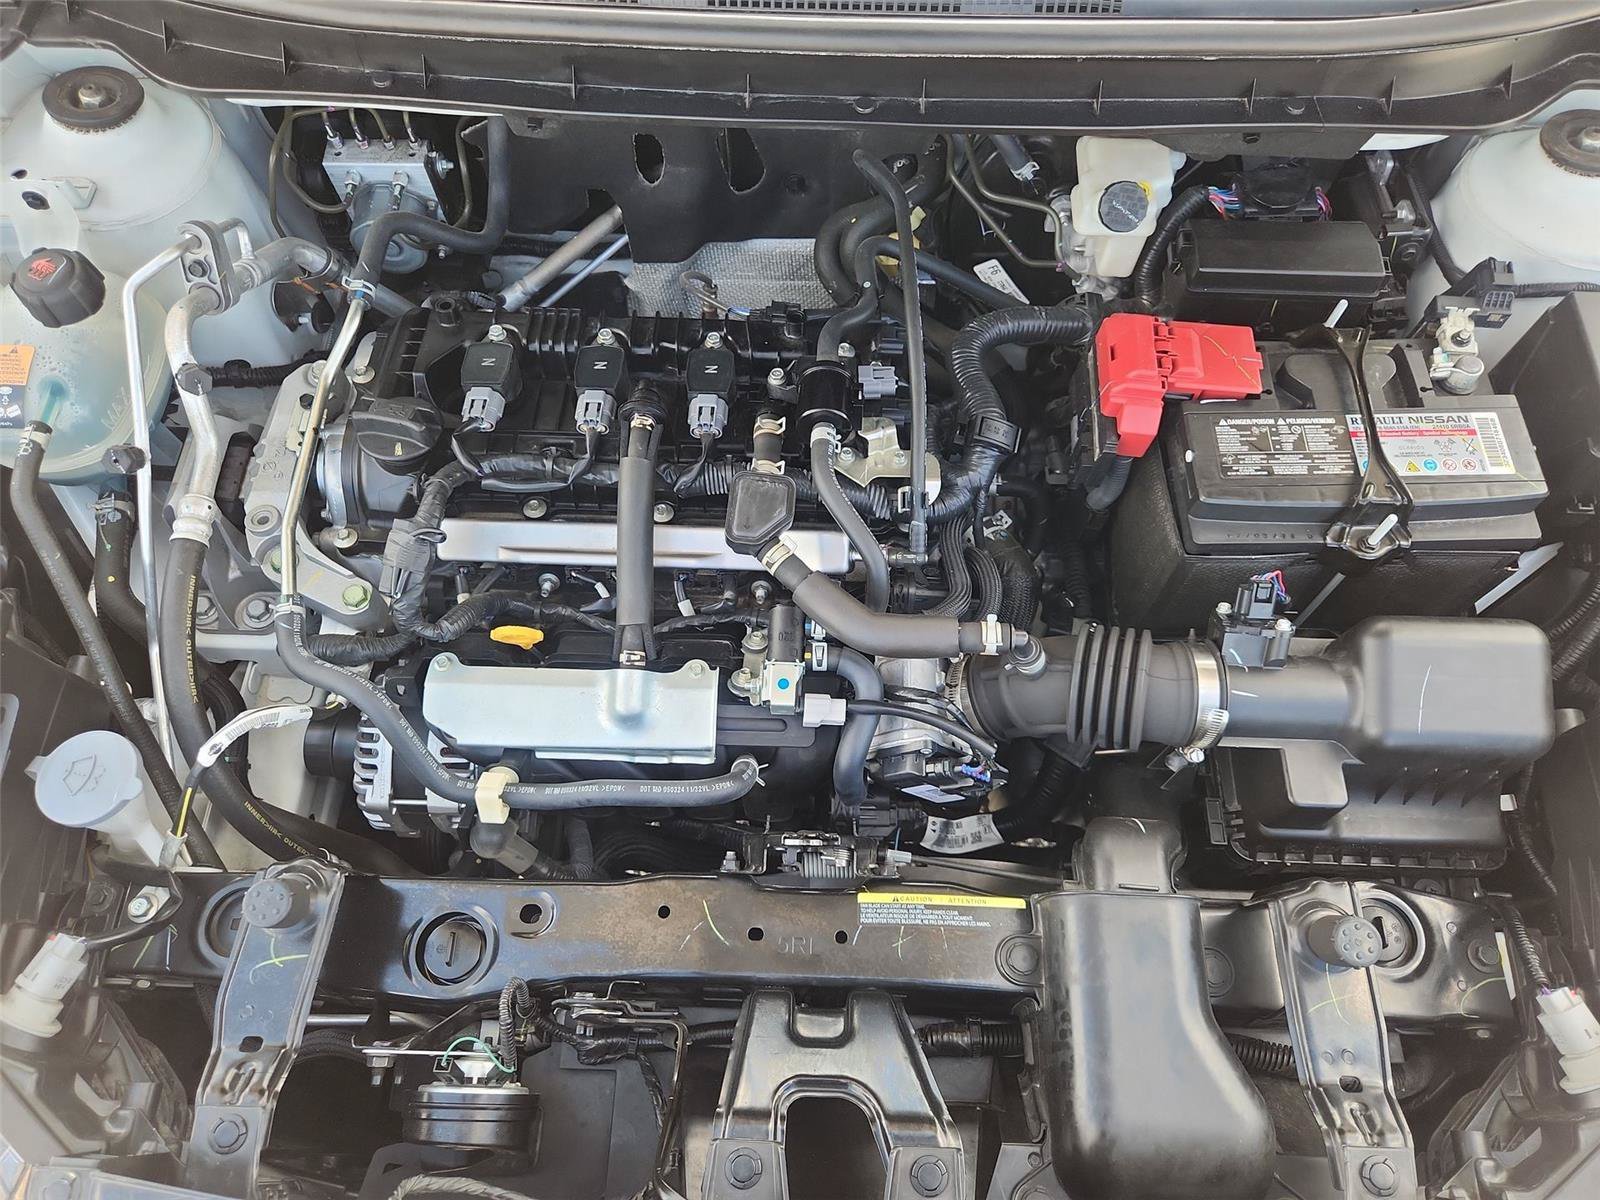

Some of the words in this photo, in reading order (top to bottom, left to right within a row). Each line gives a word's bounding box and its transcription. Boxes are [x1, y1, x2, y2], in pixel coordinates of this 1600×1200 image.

[1350, 416, 1404, 425] RAULT
[1408, 415, 1470, 424] NISSAN
[948, 897, 987, 905] ATTENTION
